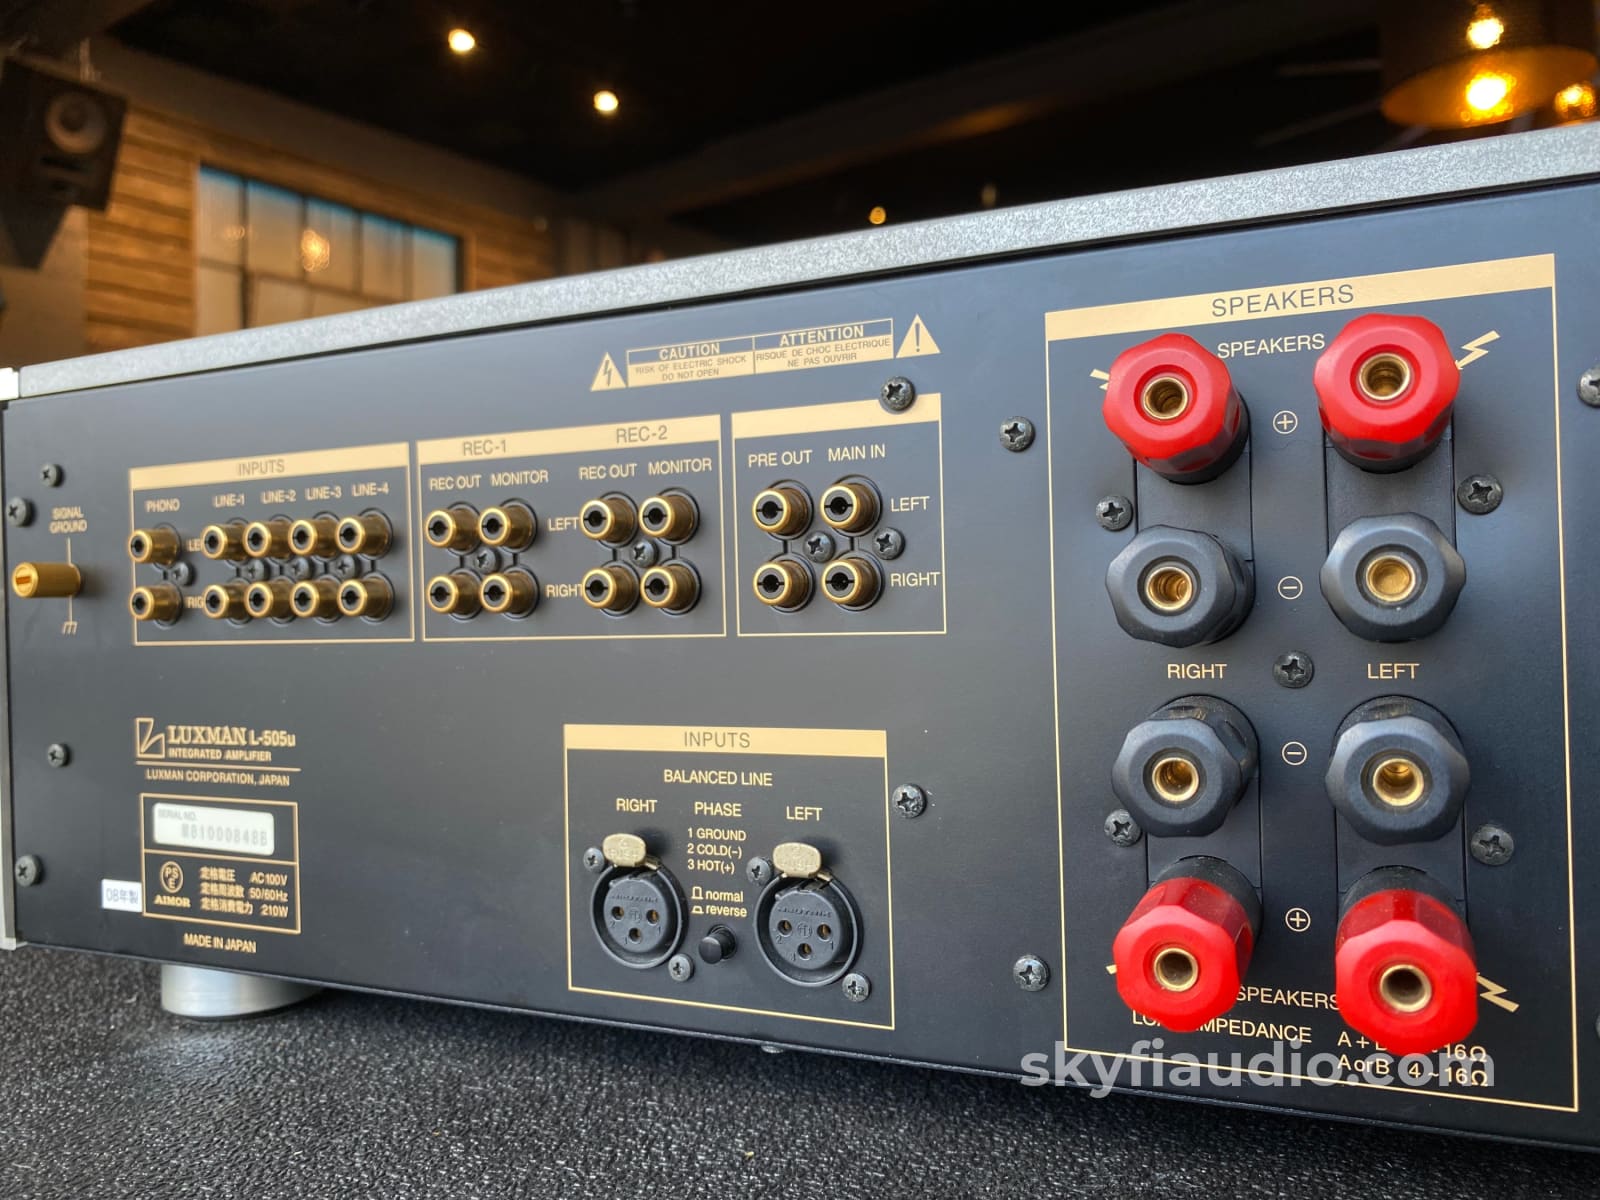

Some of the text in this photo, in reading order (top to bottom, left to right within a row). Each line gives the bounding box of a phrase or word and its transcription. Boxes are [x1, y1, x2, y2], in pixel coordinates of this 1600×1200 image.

[1211, 284, 1355, 318] SPEAKERS
[780, 325, 865, 347] ATTENTION
[659, 343, 721, 361] CAUTION
[756, 337, 891, 361] RISQUE DE CHOC ELECTRIQUE
[1217, 334, 1326, 359] SPEAKERS
[635, 354, 747, 375] RISK OF ELECTRIC SHOCK
[787, 352, 857, 368] NE PAS OUVRIR
[662, 367, 720, 381] DO NOT OPEN
[616, 425, 668, 444] REC-2
[462, 440, 508, 456] REC-1
[828, 444, 886, 462] MAIN IN
[648, 458, 713, 476] MONITOR
[748, 450, 813, 468] PRE OUT
[237, 459, 286, 476] INPUTS
[579, 463, 638, 481] REC OUT
[429, 474, 482, 491] REC OUT
[491, 470, 549, 487] MONITOR
[261, 490, 297, 504] LINE-2
[305, 485, 343, 500] LINE-3
[352, 482, 390, 497] LINE-4
[146, 498, 181, 513] PHONO
[213, 494, 246, 508] LINE-1
[890, 496, 930, 512] LEFT
[52, 506, 84, 521] SIGNAL
[50, 519, 88, 534] GROUND
[547, 516, 580, 532] LEFT
[188, 538, 203, 552] LE
[890, 571, 941, 587] RIGHT
[187, 595, 205, 609] RIG
[1167, 663, 1228, 681] RIGHT
[1367, 663, 1420, 681] LEFT
[167, 725, 297, 747] LUXMAN L-505u
[684, 731, 751, 748] INPUTS
[168, 748, 272, 762] INTEGRATED AMPLIFIER
[146, 769, 290, 787] LUXMAN CORPORATION, JAPAN
[664, 769, 773, 786] BALANCED LINE
[616, 798, 657, 813] RIGHT
[694, 802, 742, 818] PHASE
[786, 806, 823, 822] LEFT
[687, 827, 746, 842] 1 GROUND
[687, 843, 694, 854] 2
[687, 859, 735, 874] 3 HOT(+)
[248, 887, 289, 902] 50/60Hz
[705, 889, 744, 903] normal
[260, 904, 289, 918] 210W
[705, 905, 748, 918] reverse
[184, 932, 257, 954] MADE IN JAPAN
[1237, 985, 1340, 1010] SPEAKERS
[1196, 1017, 1312, 1044] MPEDANCE
